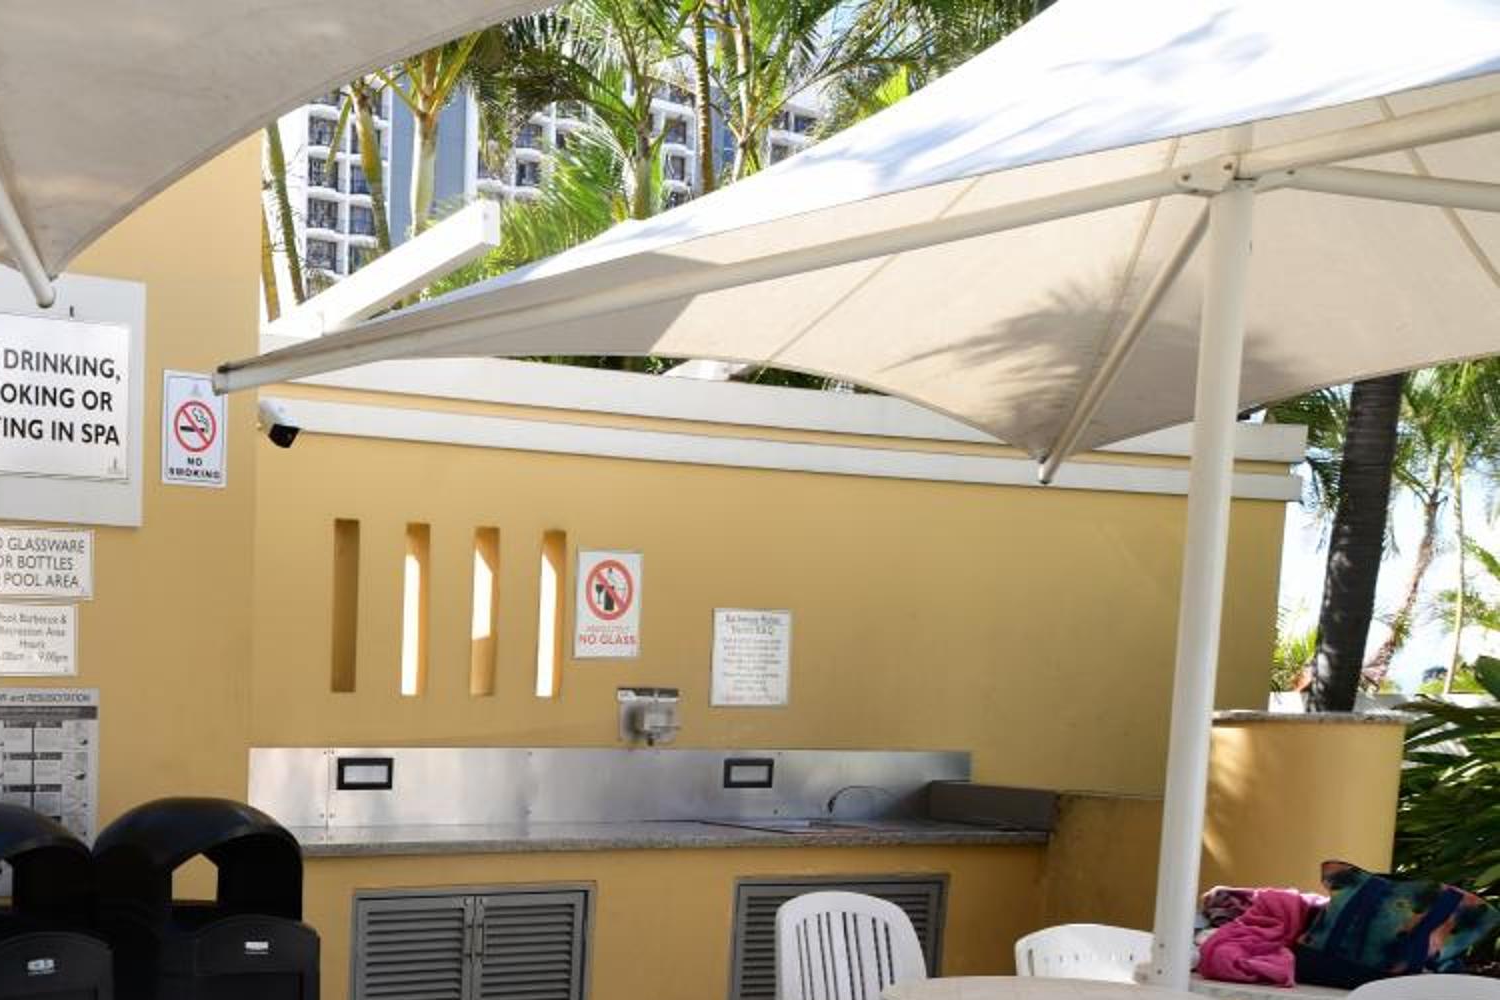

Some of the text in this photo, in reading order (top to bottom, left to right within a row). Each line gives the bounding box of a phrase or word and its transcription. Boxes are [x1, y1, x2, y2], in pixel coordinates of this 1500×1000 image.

[3, 348, 121, 384] DRINKING,
[81, 389, 113, 412] OR
[51, 420, 74, 442] IN
[81, 423, 120, 446] SPA
[187, 457, 203, 467] NO
[169, 467, 221, 479] SMOKING
[8, 537, 85, 554] GLASSWARE
[17, 555, 74, 571] BOTTLES
[4, 572, 44, 587] POOL
[46, 574, 79, 588] AREA
[579, 634, 636, 645] NO GLASS
